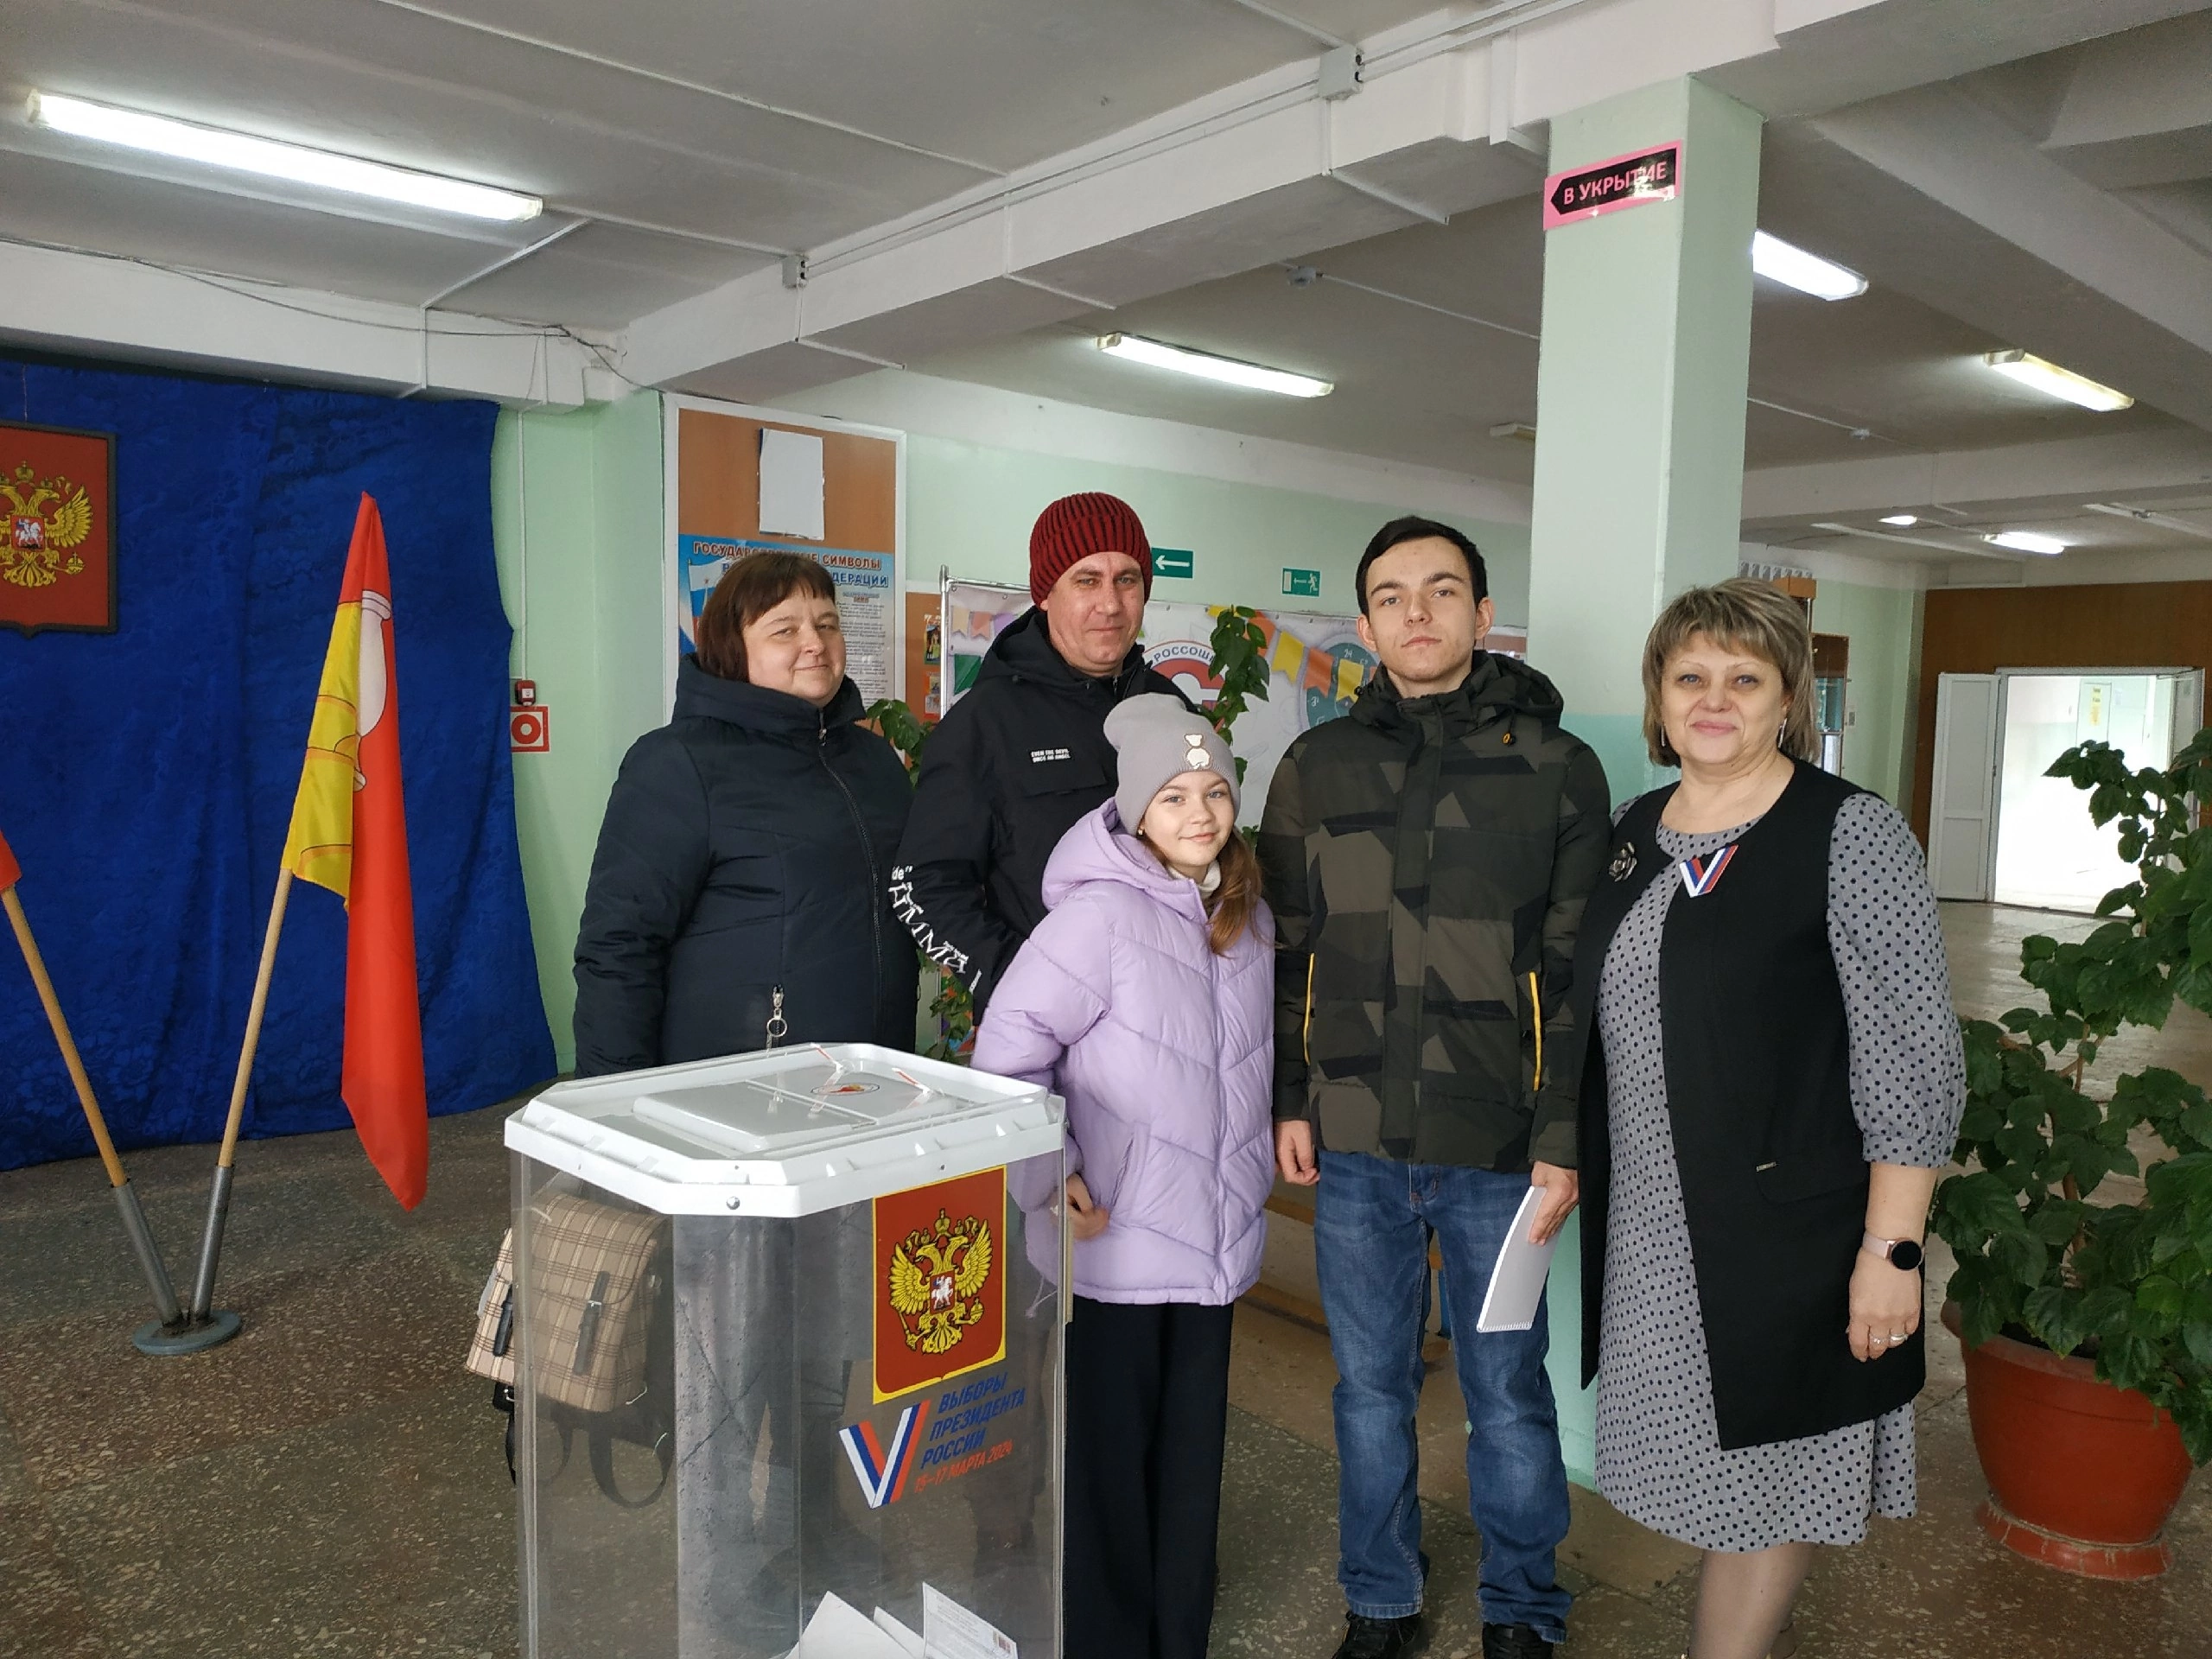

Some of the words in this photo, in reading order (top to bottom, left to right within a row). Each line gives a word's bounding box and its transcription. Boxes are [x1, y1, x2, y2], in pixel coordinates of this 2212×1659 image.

[1563, 187, 1574, 205] В
[823, 554, 881, 570] СИМВОЛЫ
[832, 571, 887, 587] ДЕРАЦИИ
[938, 1371, 1008, 1414] ВЫБОРЫ
[929, 1387, 1026, 1441] ПРЕЗИДЕНТА
[920, 1427, 987, 1469] РОССИИ
[948, 1451, 986, 1479] МАРТА
